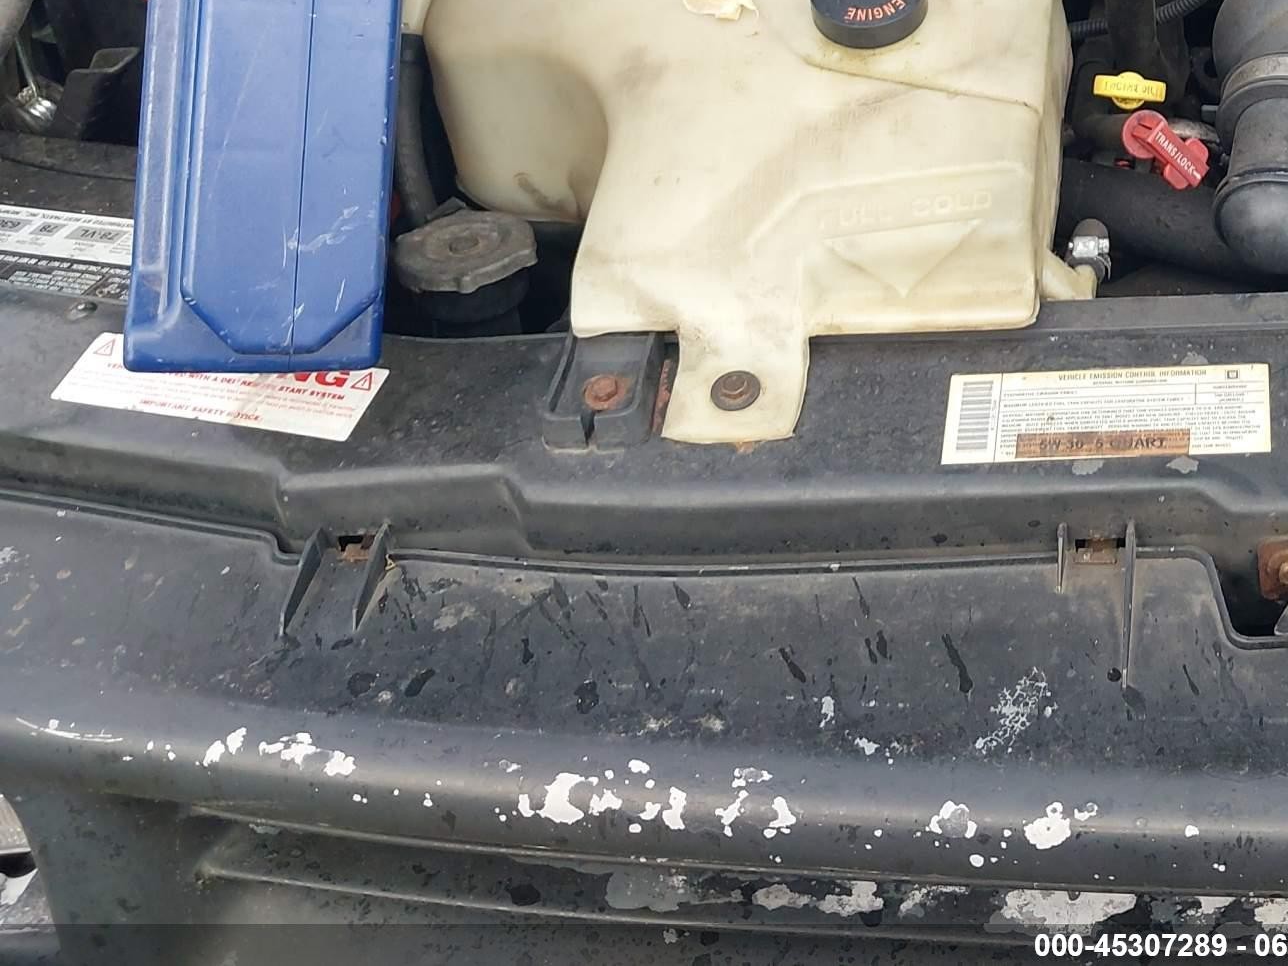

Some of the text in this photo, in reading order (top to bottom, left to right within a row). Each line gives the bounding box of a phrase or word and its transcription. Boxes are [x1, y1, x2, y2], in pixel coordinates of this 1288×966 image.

[1155, 131, 1196, 175] TRANS/LOCK
[911, 190, 992, 217] COLD
[39, 224, 59, 233] 78
[1058, 369, 1207, 381] VEHICLE EMISSION CONTROL INFORMATION
[278, 386, 307, 395] START
[309, 389, 345, 401] SYSTEM
[191, 405, 225, 417] SAFETY
